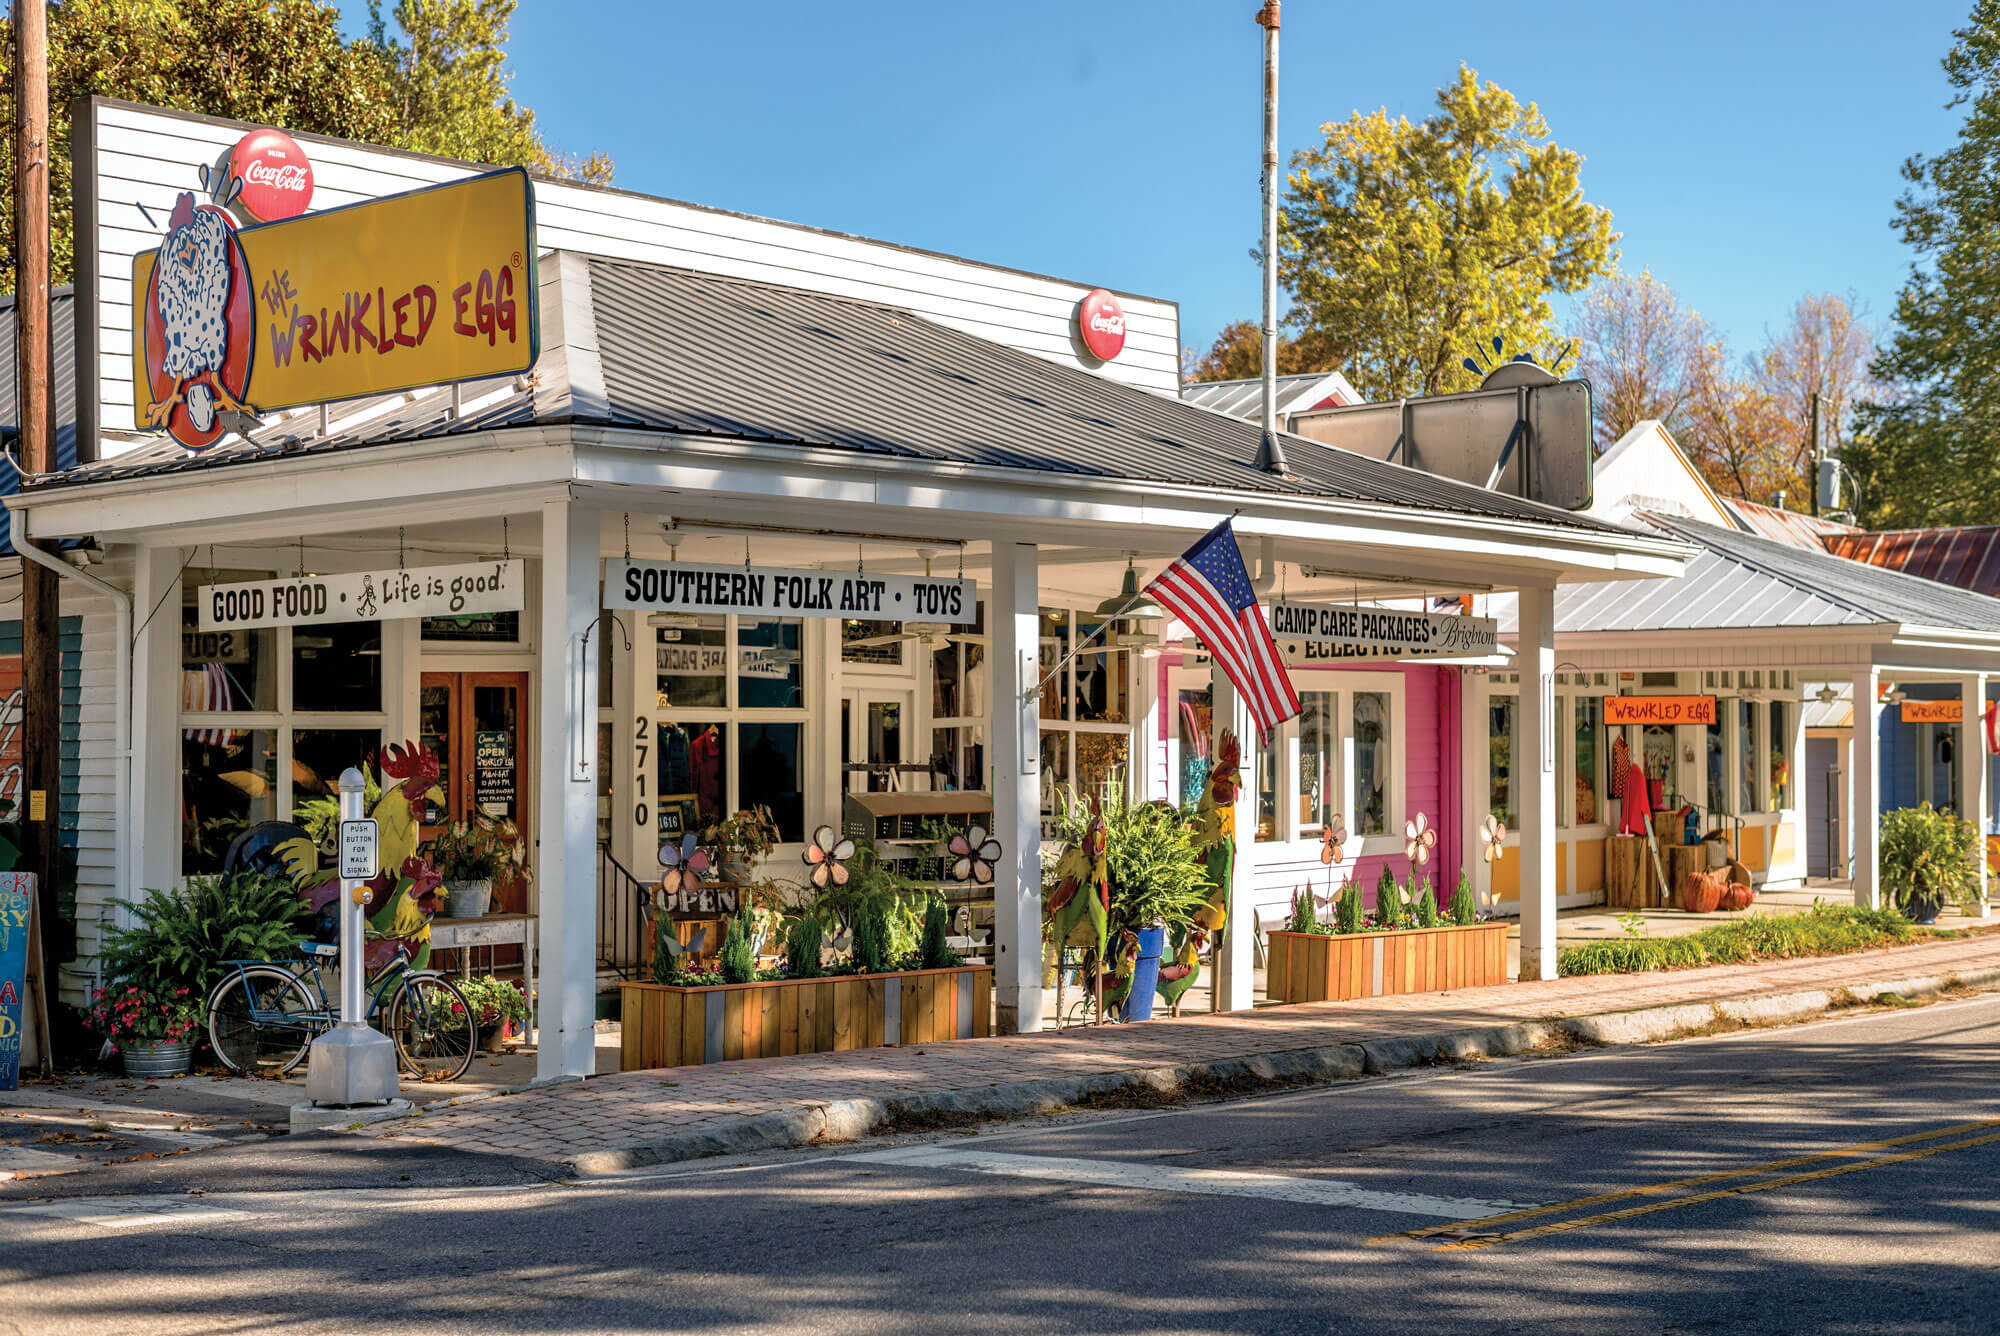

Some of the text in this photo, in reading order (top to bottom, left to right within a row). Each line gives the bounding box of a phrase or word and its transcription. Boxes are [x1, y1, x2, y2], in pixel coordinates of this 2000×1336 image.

[261, 269, 297, 318] THE
[271, 265, 516, 368] WRINKLED EGG
[213, 588, 264, 622] GOOD
[272, 583, 327, 618] FOOD
[382, 573, 420, 604] Life
[427, 576, 444, 596] is
[625, 567, 962, 616] SOUTHERN FOLK ART TOYS
[1274, 606, 1495, 650] CAMP CARE PACKAGES Brighton
[1615, 702, 1682, 720] WRINKLED
[1687, 702, 1710, 721] EGG
[478, 747, 505, 757] OPEN
[656, 886, 736, 913] OPEN
